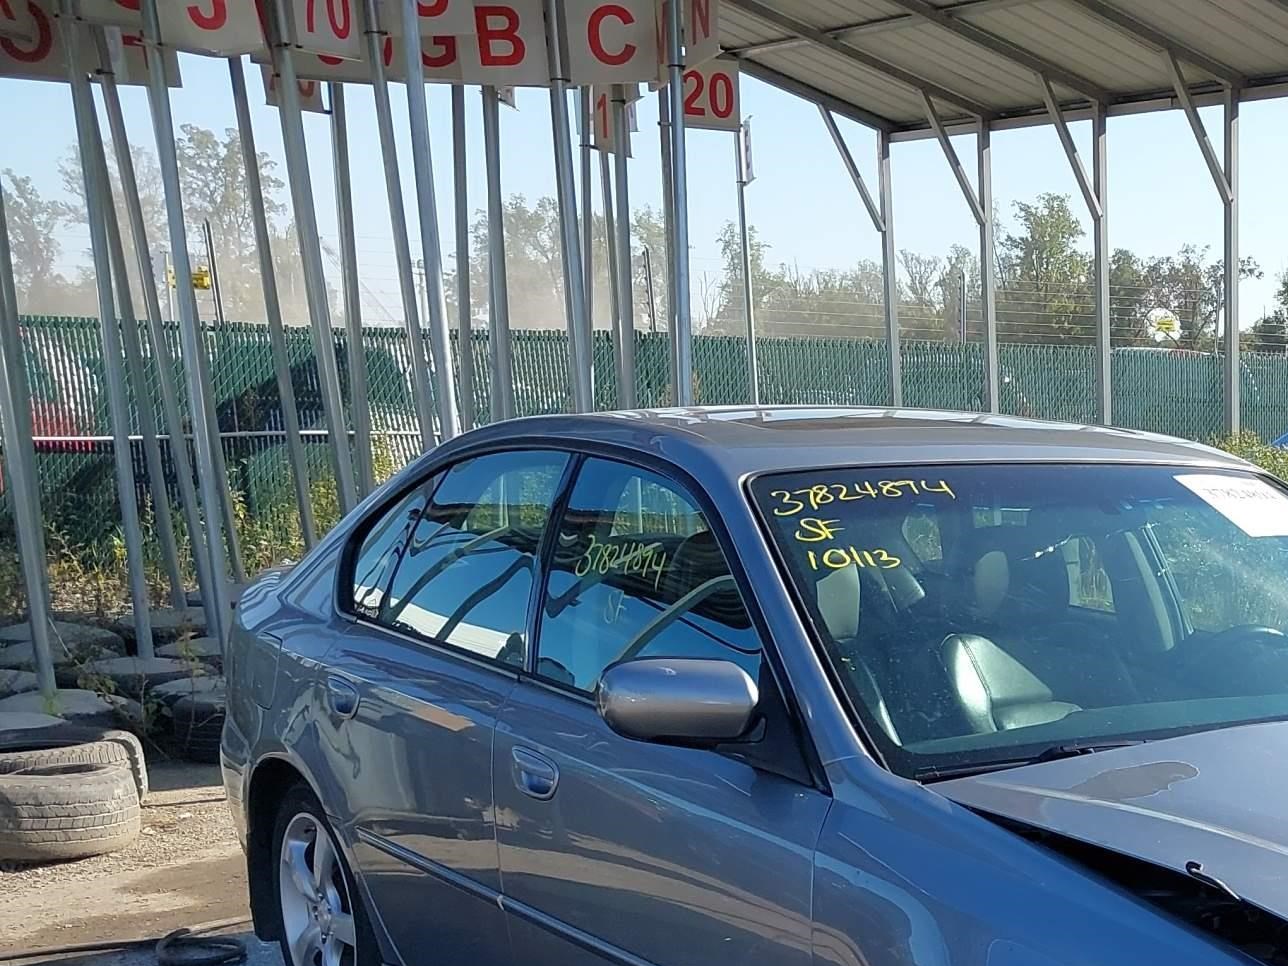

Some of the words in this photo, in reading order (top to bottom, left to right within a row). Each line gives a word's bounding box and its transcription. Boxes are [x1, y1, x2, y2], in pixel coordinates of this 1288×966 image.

[474, 6, 526, 66] B
[587, 5, 636, 65] C
[683, 70, 735, 119] 20
[795, 517, 846, 541] SF
